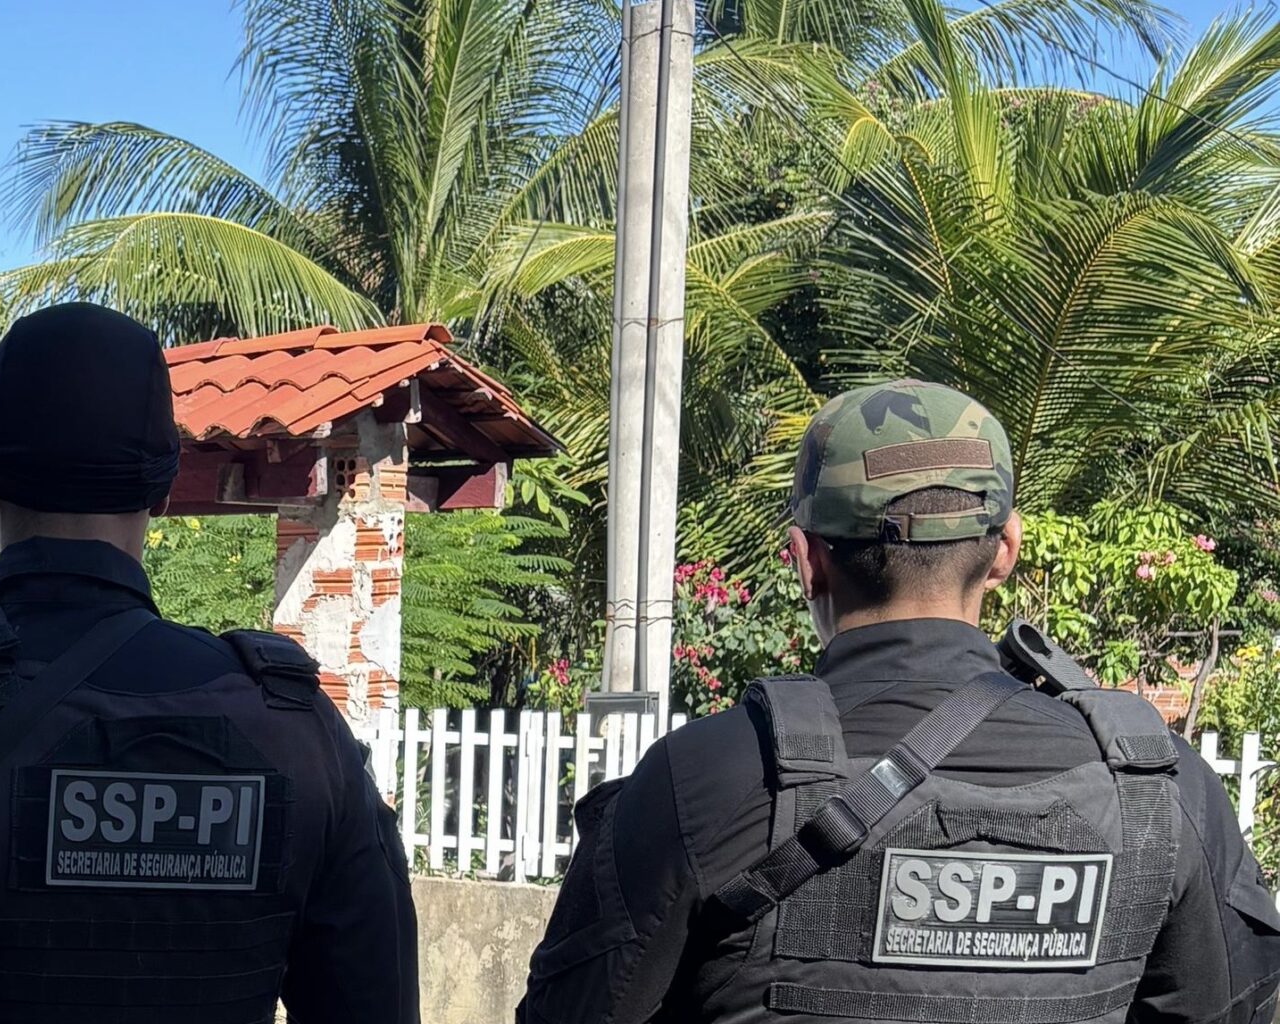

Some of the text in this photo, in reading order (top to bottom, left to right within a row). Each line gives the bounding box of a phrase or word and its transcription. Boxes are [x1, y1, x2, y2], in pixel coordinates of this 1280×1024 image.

[60, 780, 253, 845] SSP-PI
[57, 850, 246, 882] SECRETARIA DE SEGURANÇA PÚBLICA
[891, 859, 1098, 924] SSP-PI
[885, 927, 1087, 961] SECRETARIA DE SEGURANÇA PÚBLICA
